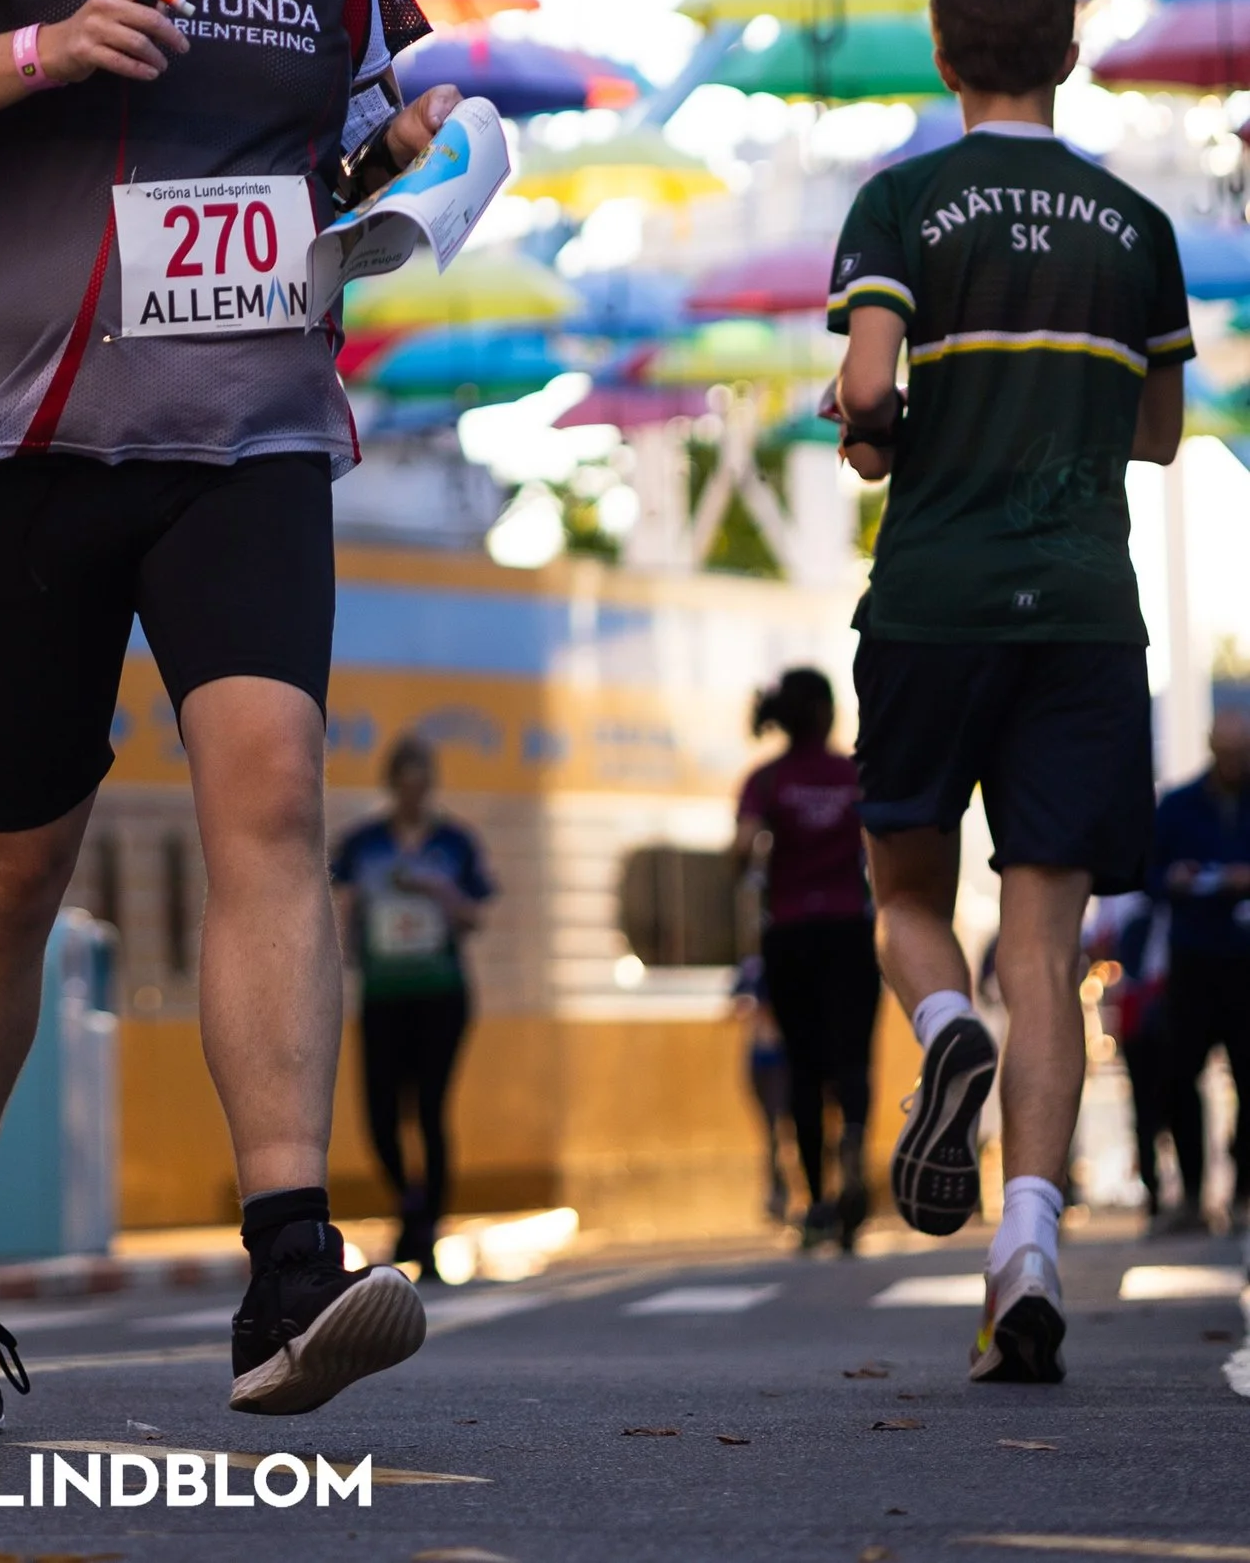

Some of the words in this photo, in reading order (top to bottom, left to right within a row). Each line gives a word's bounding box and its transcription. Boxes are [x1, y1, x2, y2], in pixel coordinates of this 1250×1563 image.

[174, 18, 316, 54] RIENTERING
[153, 187, 191, 200] Gröna
[194, 183, 271, 198] Lund-sprinten
[163, 200, 277, 278] 270
[920, 186, 1139, 251] SNÄTTRINGE
[1010, 223, 1051, 252] SK
[140, 275, 307, 325] ALLEMAN
